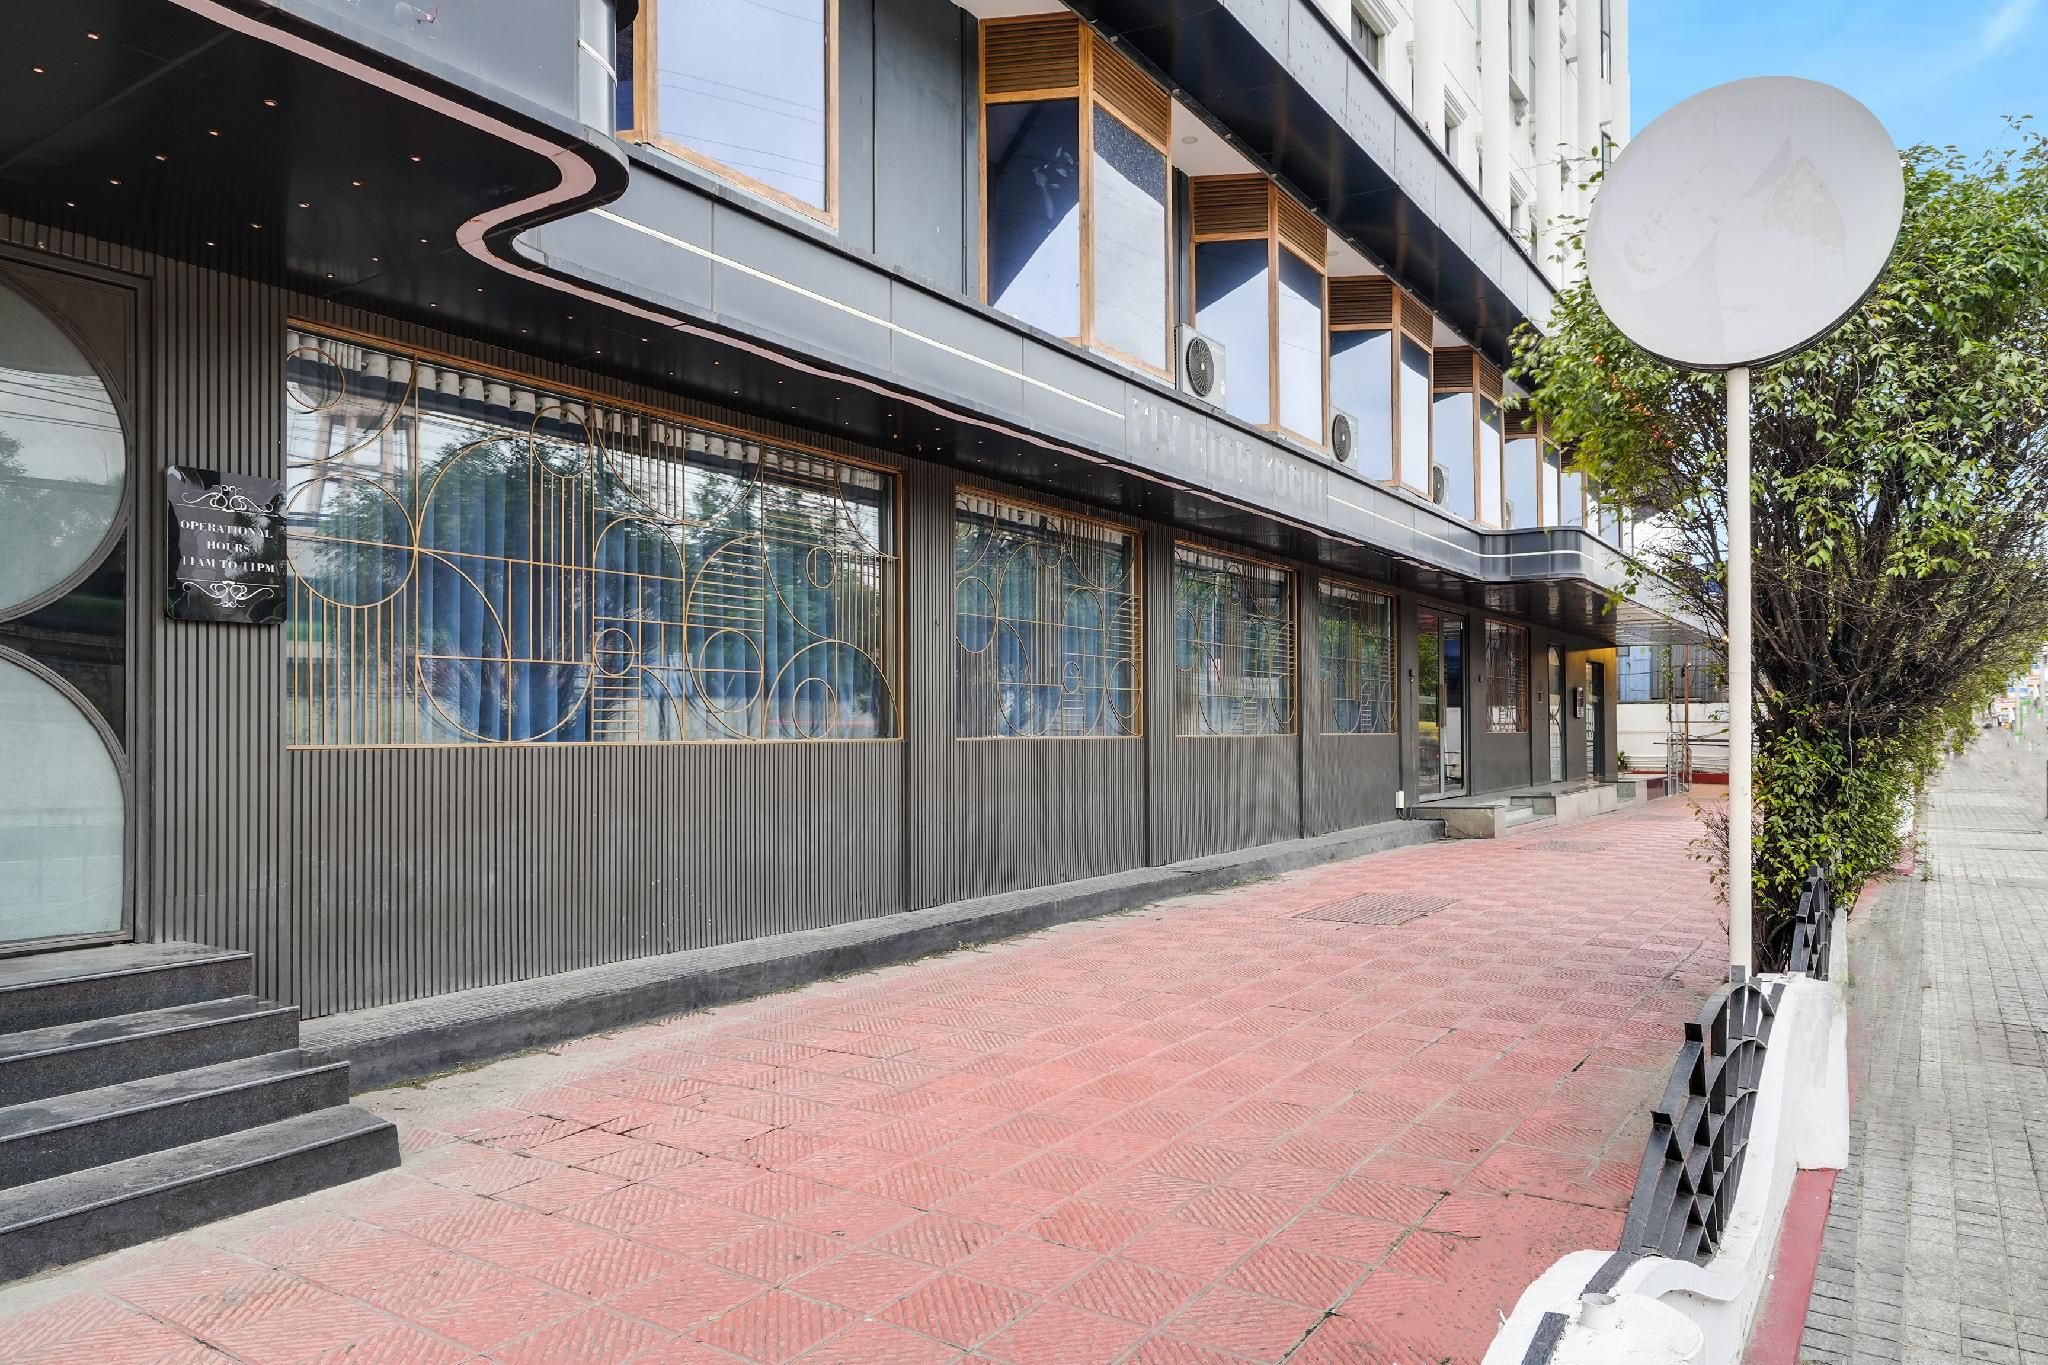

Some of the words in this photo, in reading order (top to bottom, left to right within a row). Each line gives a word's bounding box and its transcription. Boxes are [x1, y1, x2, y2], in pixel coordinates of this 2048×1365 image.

[180, 519, 273, 539] OPERATIONAL
[207, 540, 250, 553] HOURS
[182, 556, 215, 568] 11AM
[219, 559, 237, 570] TO
[242, 561, 275, 573] 11PM
